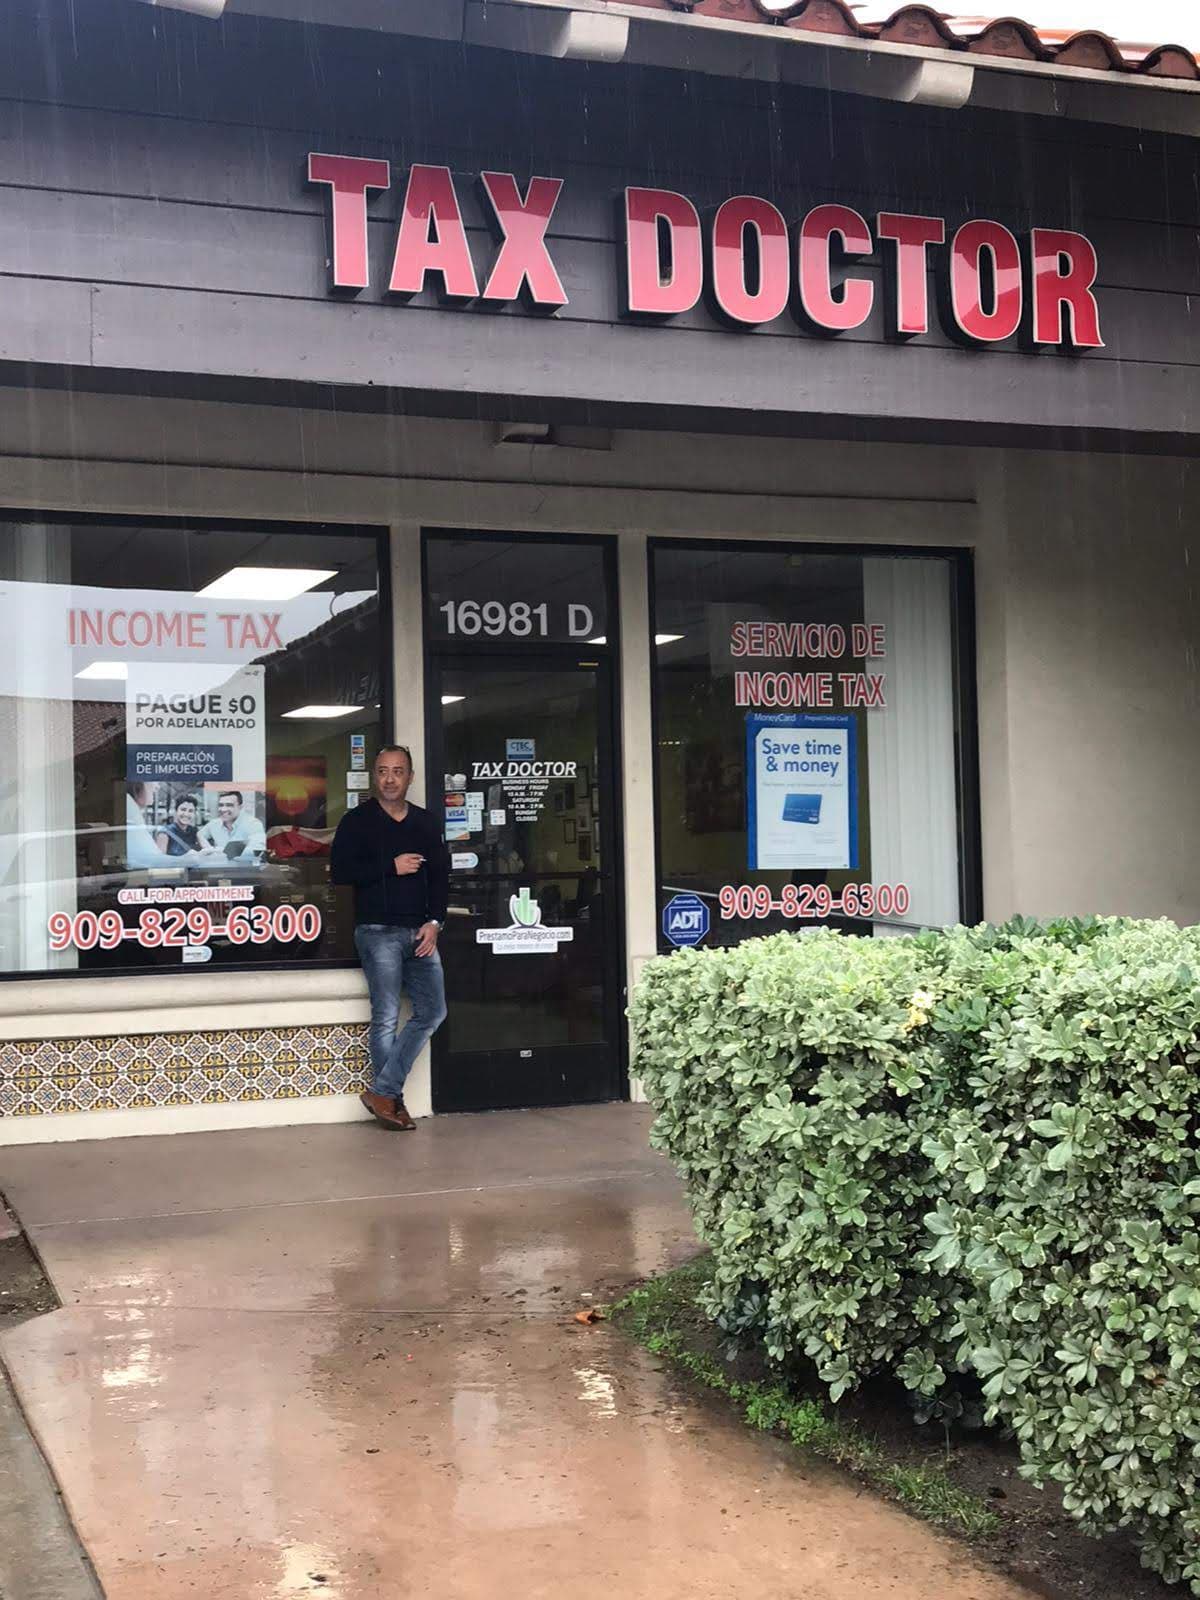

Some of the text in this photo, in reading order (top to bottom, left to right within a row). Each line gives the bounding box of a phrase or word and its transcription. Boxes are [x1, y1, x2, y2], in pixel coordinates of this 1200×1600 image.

[307, 152, 1106, 348] TAX DOCTOR
[440, 600, 593, 636] 16981 D
[68, 609, 284, 649] INCOME TAX
[730, 621, 886, 658] SERVICIO DE
[735, 671, 887, 707] INCOME TAX
[136, 693, 256, 714] PAGUE $0
[136, 717, 256, 729] POR ADELANTADO
[136, 751, 215, 762] PREPARACIÓN
[762, 738, 842, 755] Save time
[136, 764, 220, 774] DE IMPUESTOS
[472, 762, 577, 777] TAX DOCTOR
[766, 756, 839, 777] & money
[118, 886, 253, 904] CALL FOR APPOINTMENT
[719, 884, 909, 920] 909-829-6300
[48, 904, 321, 950] 909-829-6300
[671, 911, 702, 929] ADT
